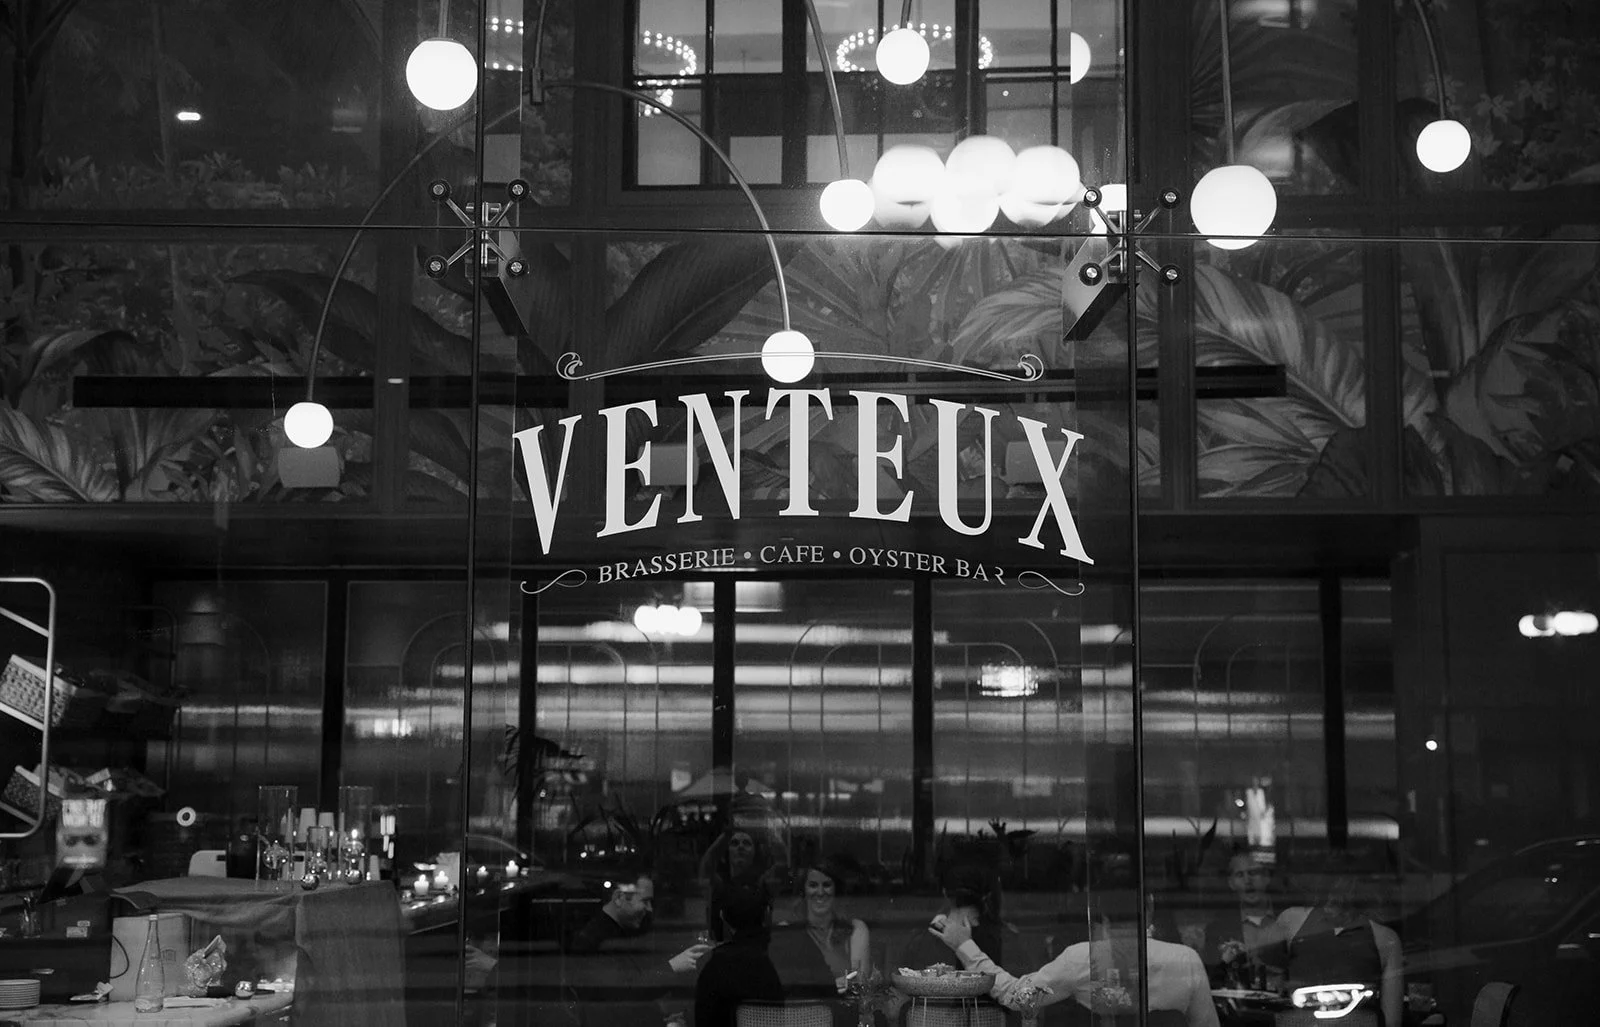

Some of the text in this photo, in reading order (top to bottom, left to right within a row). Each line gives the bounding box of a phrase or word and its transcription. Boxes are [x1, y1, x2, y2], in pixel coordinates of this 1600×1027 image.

[511, 387, 1095, 565] VENTEUX
[598, 545, 1006, 586] BRASSERIE CAFE OYSTER BAR
